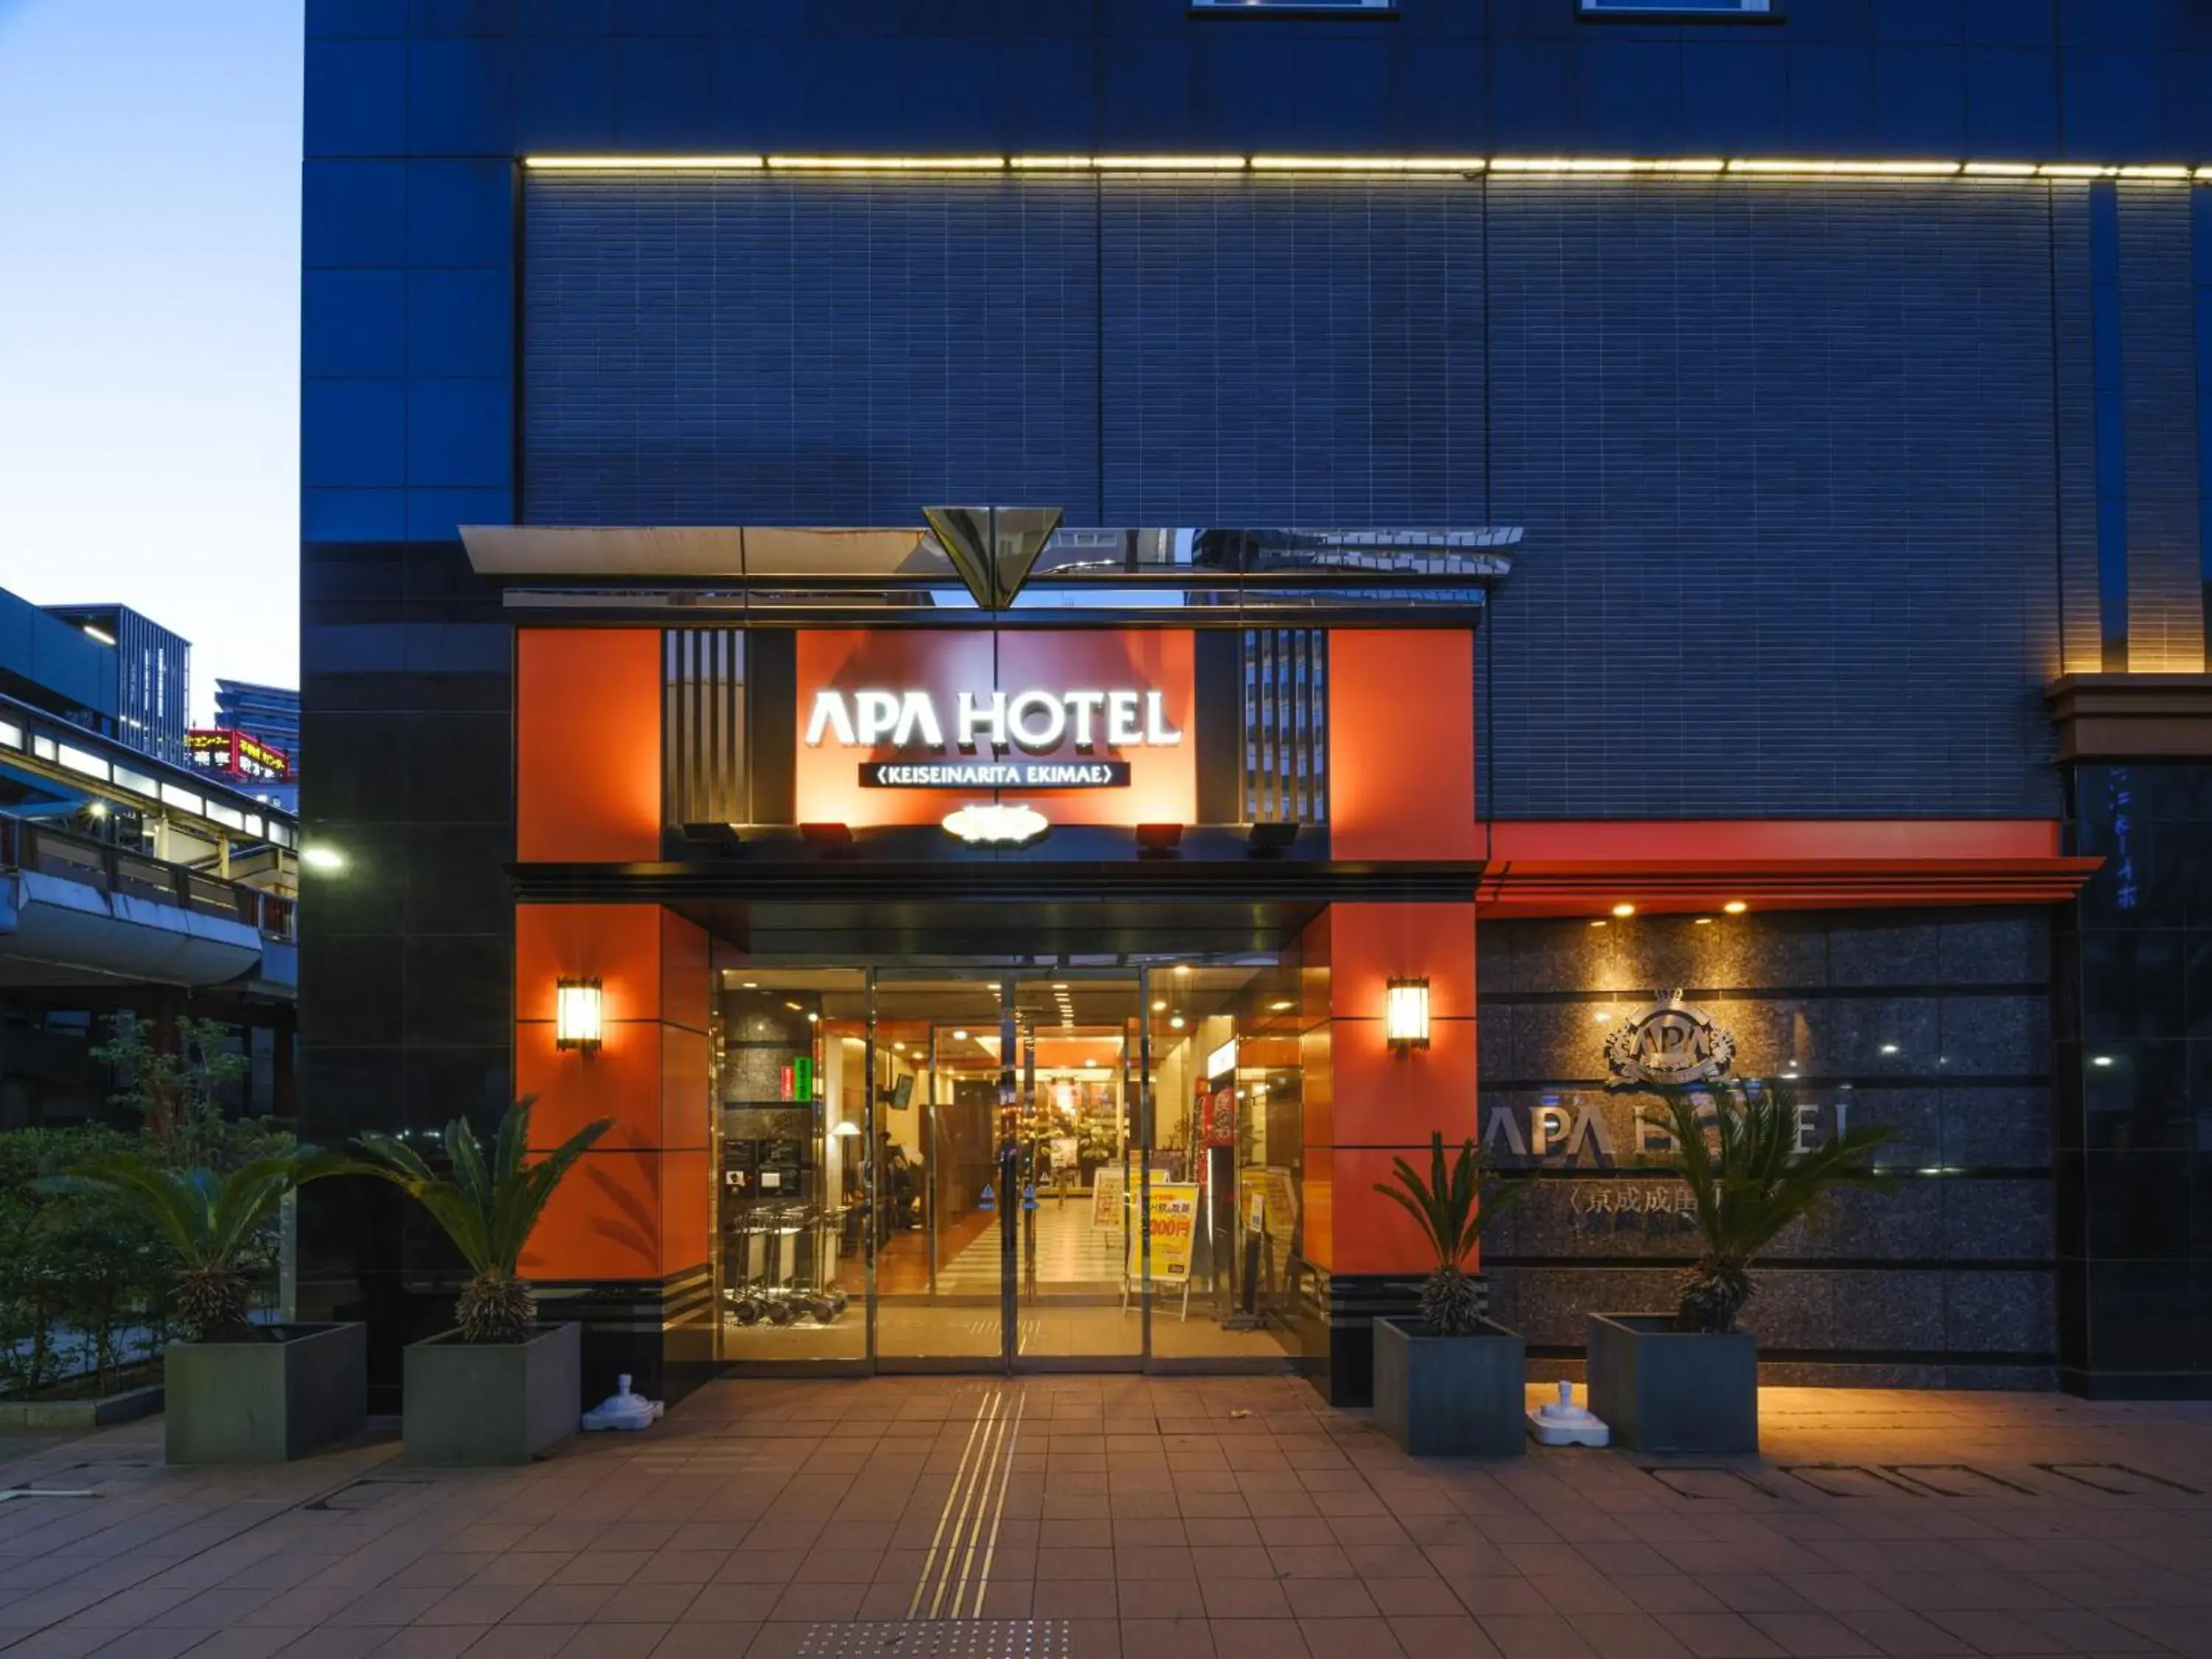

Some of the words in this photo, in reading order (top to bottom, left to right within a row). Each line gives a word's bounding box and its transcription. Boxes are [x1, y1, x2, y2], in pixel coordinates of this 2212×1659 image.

[805, 691, 944, 747] APA
[957, 690, 1183, 747] HOTEL
[1483, 1107, 1616, 1155] APA
